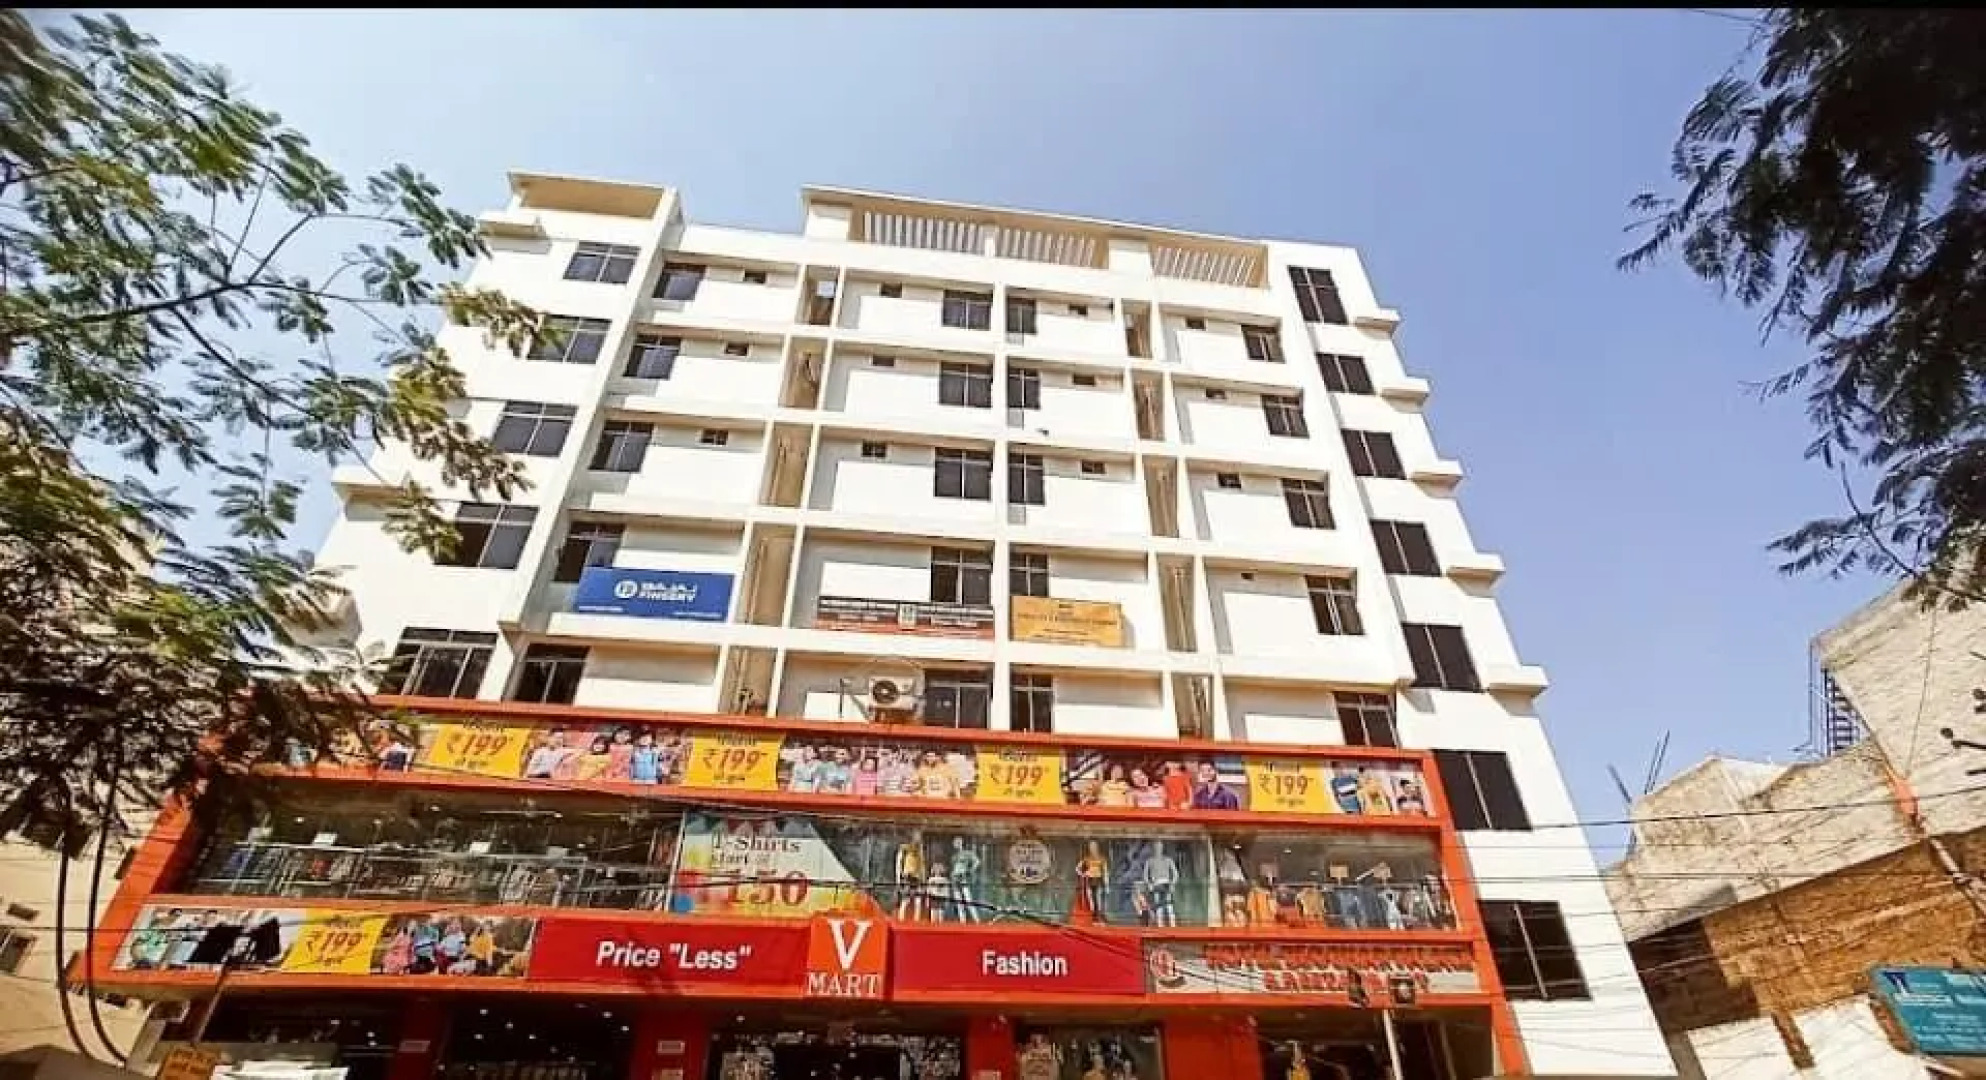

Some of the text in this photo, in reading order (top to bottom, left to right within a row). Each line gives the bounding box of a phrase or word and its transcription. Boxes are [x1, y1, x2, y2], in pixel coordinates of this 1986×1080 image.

[596, 940, 752, 969] Price "Less"
[827, 918, 873, 971] V
[982, 949, 1069, 977] Fashion
[806, 971, 881, 998] MART
